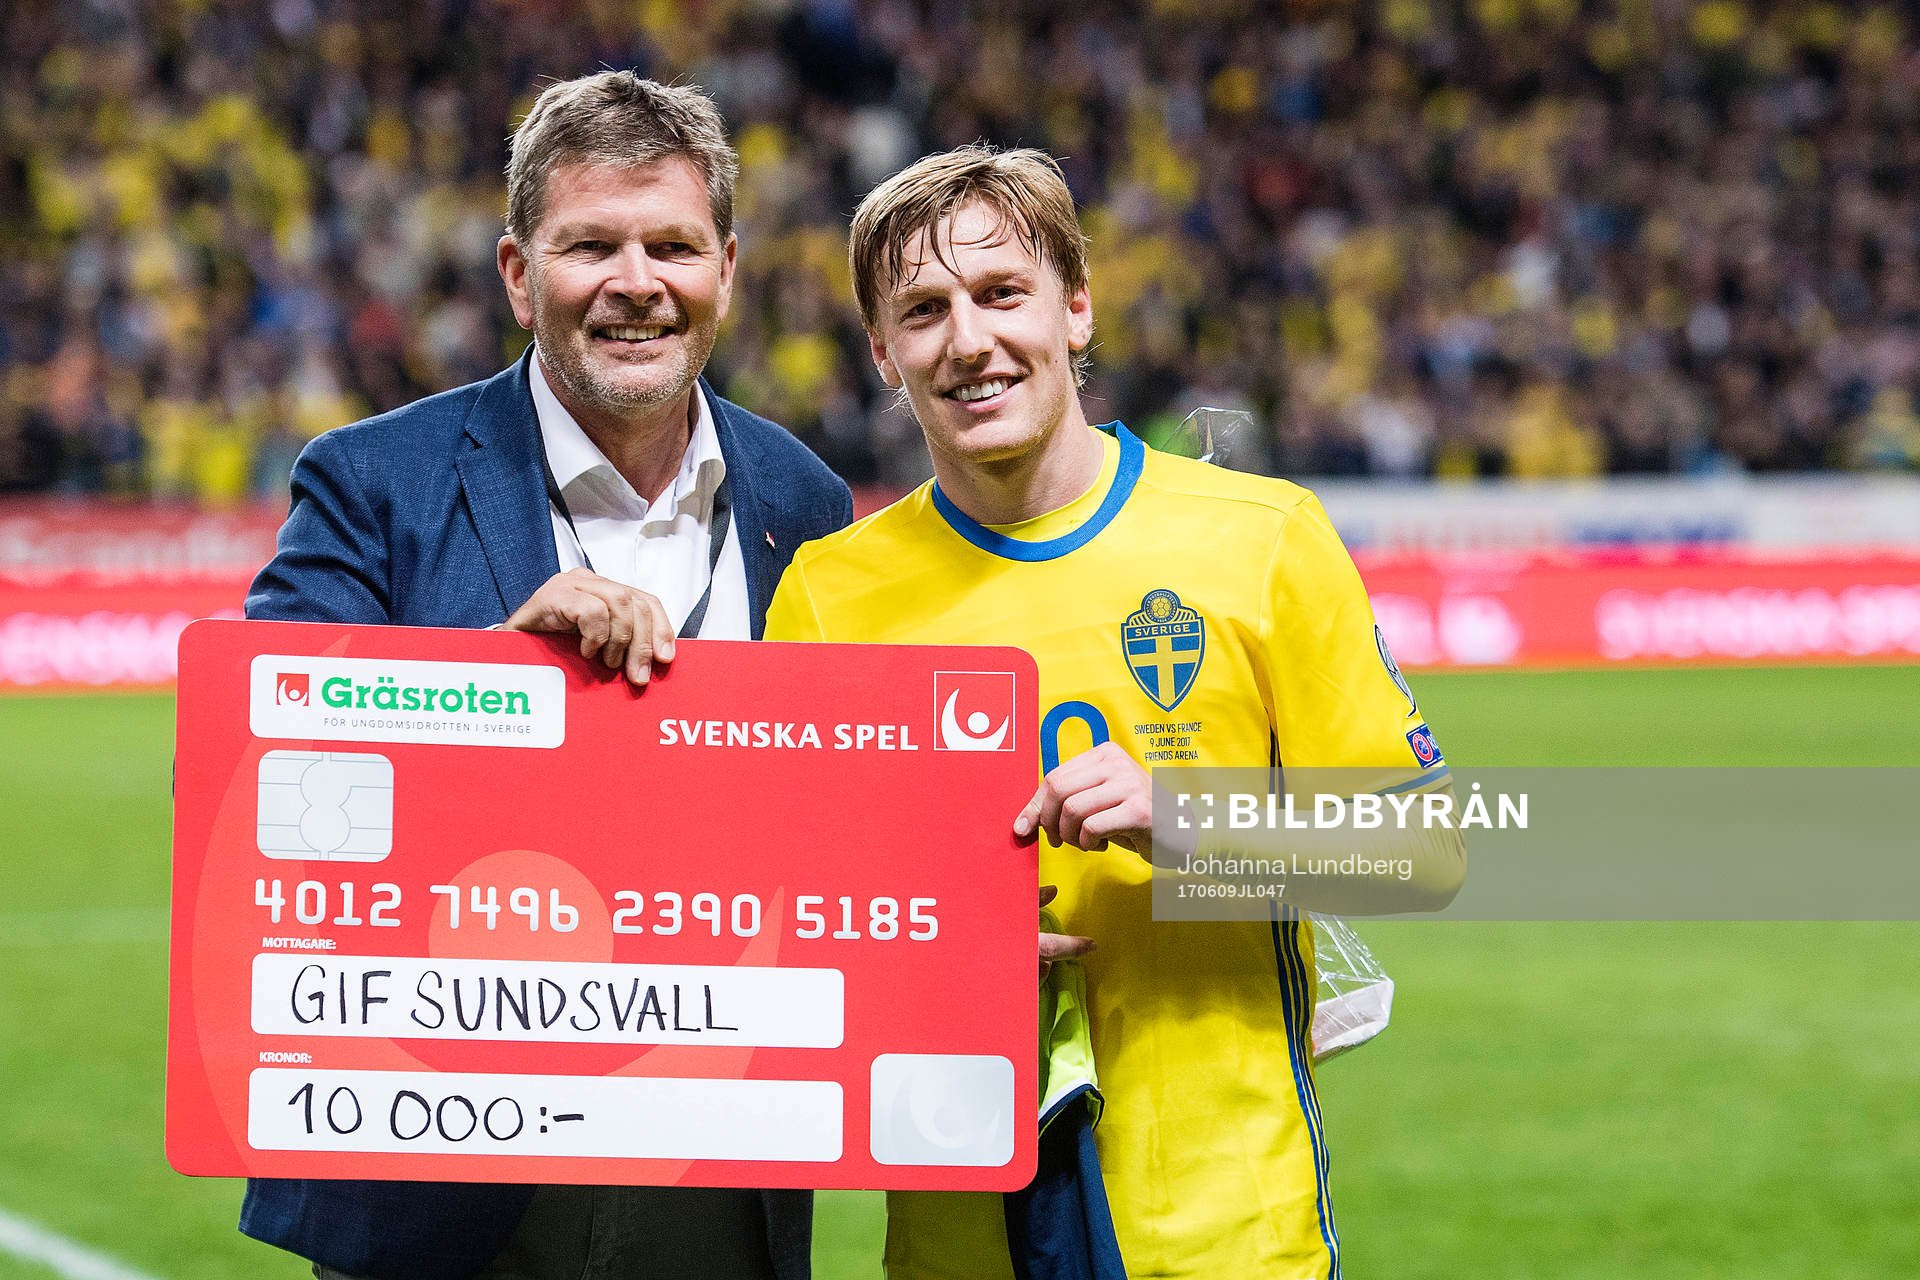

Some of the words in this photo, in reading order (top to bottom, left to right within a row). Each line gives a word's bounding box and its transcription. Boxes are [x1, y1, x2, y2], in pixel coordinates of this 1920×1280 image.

[1135, 624, 1191, 637] SVERIGE
[322, 676, 531, 715] Gräsroten
[323, 717, 346, 727] FÖR
[351, 719, 470, 732] UNGDOMSIDROTTEN
[484, 724, 532, 734] SVERIGE
[1134, 724, 1165, 735] SWEDEN
[1166, 723, 1177, 733] VS
[1177, 721, 1202, 733] FRANCE
[659, 719, 823, 749] SVENSKA
[833, 724, 919, 751] SPEL
[1149, 737, 1155, 747] 9
[1156, 737, 1176, 747] JUNE
[1177, 736, 1191, 747] 2017
[1145, 750, 1173, 762] FRIENDS
[1174, 750, 1199, 760] ARENA
[255, 878, 401, 927] 4012
[430, 884, 580, 932] 7496
[612, 890, 761, 938] 2390
[796, 895, 939, 941] 5185
[262, 937, 337, 950] MOTTAGARE:
[291, 964, 392, 1024] GIF
[411, 970, 739, 1032] SUNDSVALL
[259, 1051, 313, 1064] KRONOR:
[288, 1083, 363, 1136] 10
